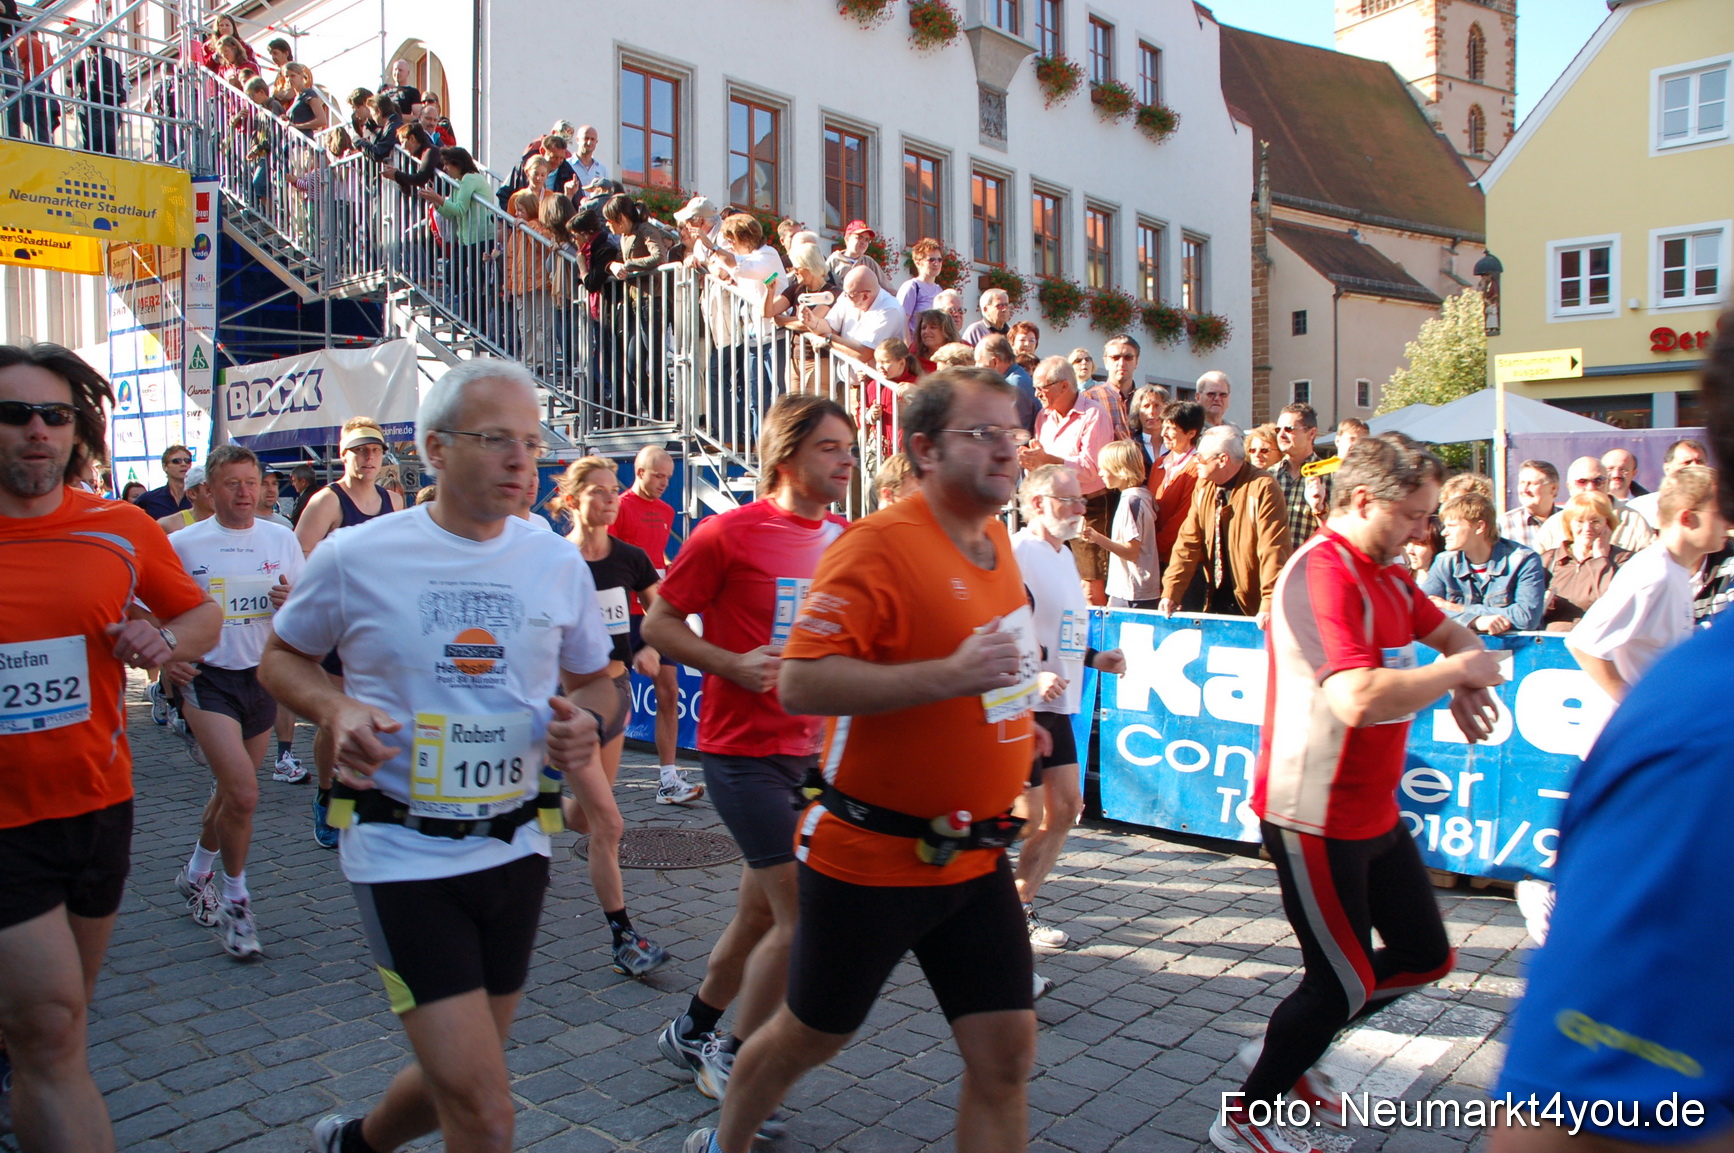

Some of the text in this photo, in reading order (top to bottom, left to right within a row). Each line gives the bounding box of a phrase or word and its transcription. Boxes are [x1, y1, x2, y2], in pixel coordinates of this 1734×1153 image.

[9, 188, 157, 219] Neumarkter Stadtlauf
[16, 235, 72, 250] Stadtlauf
[1649, 326, 1711, 353] Der
[227, 368, 324, 421] BOCK
[230, 596, 269, 612] 1210
[0, 651, 49, 670] Stefan
[2, 676, 81, 709] 2352
[451, 722, 507, 744] Robert
[453, 756, 524, 789] 1018
